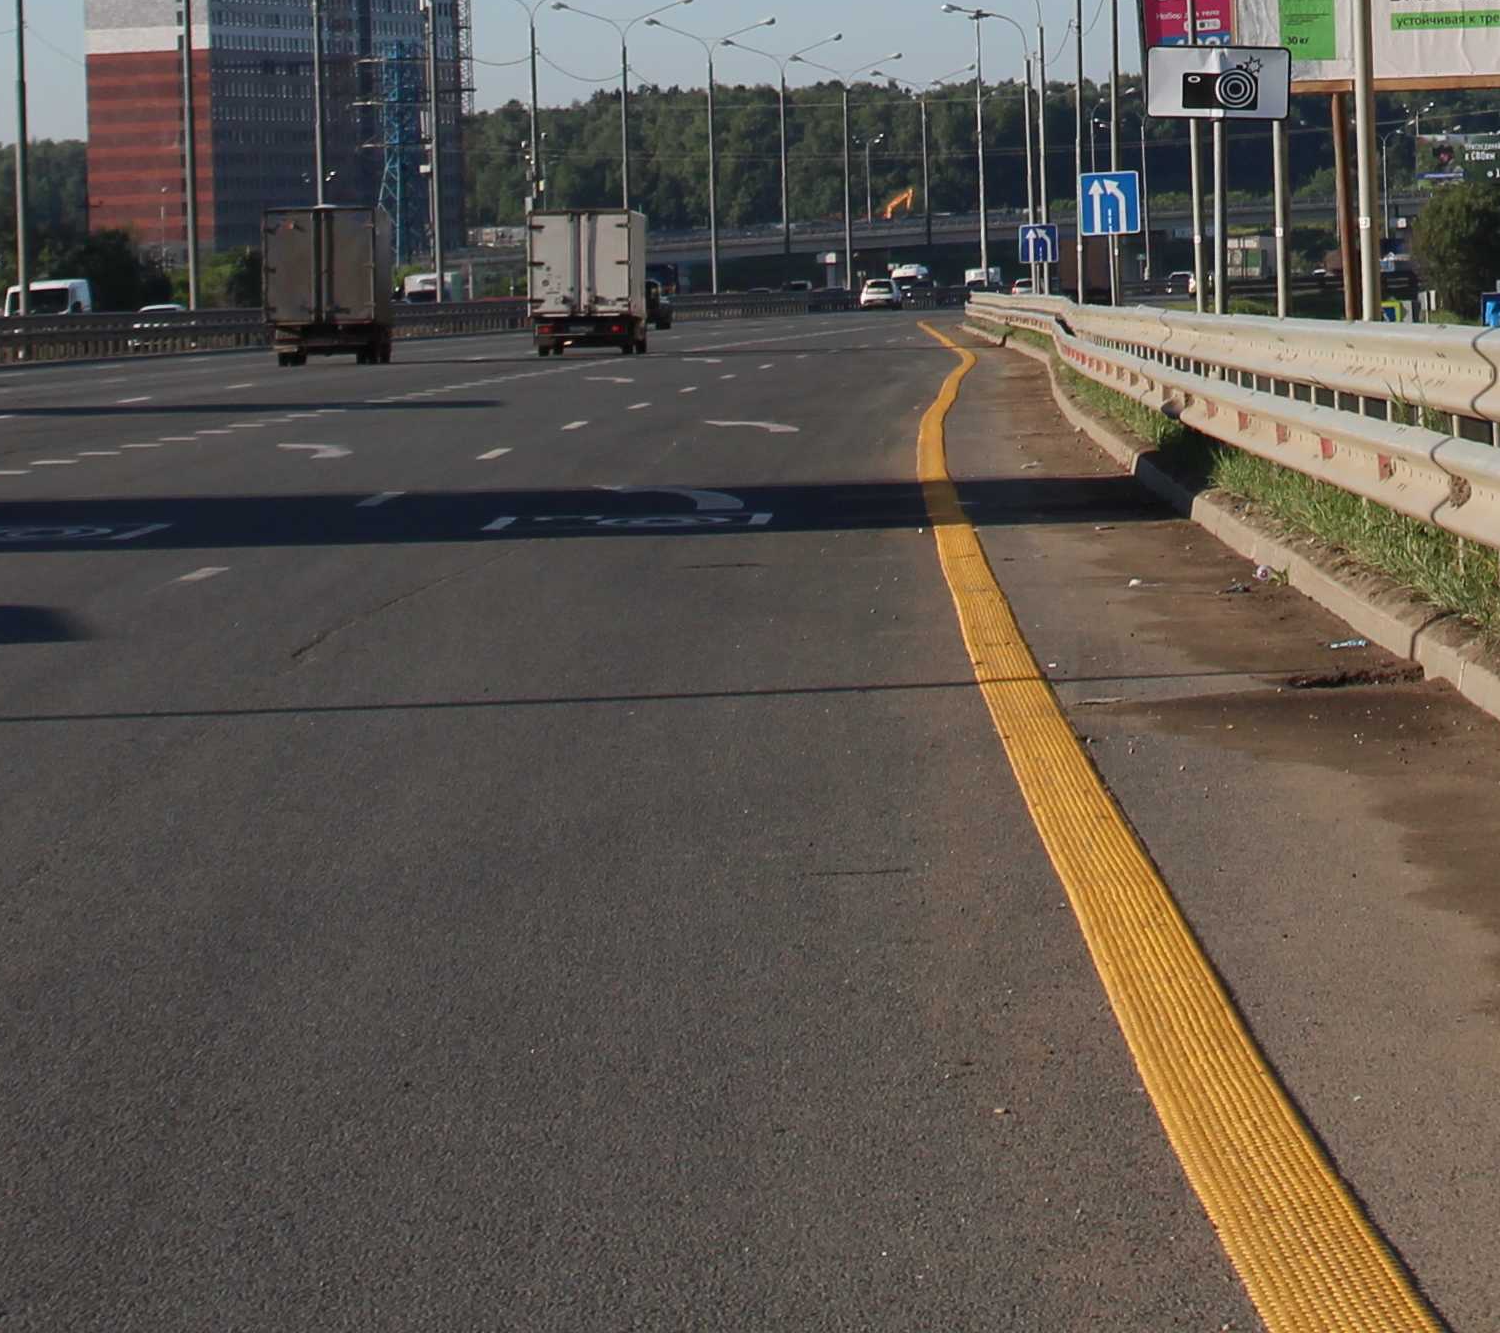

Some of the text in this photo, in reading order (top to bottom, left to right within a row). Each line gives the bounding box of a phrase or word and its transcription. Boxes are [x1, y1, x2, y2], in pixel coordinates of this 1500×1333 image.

[1395, 13, 1466, 29] устойчивая
[1469, 15, 1477, 24] к
[1287, 36, 1298, 46] 30
